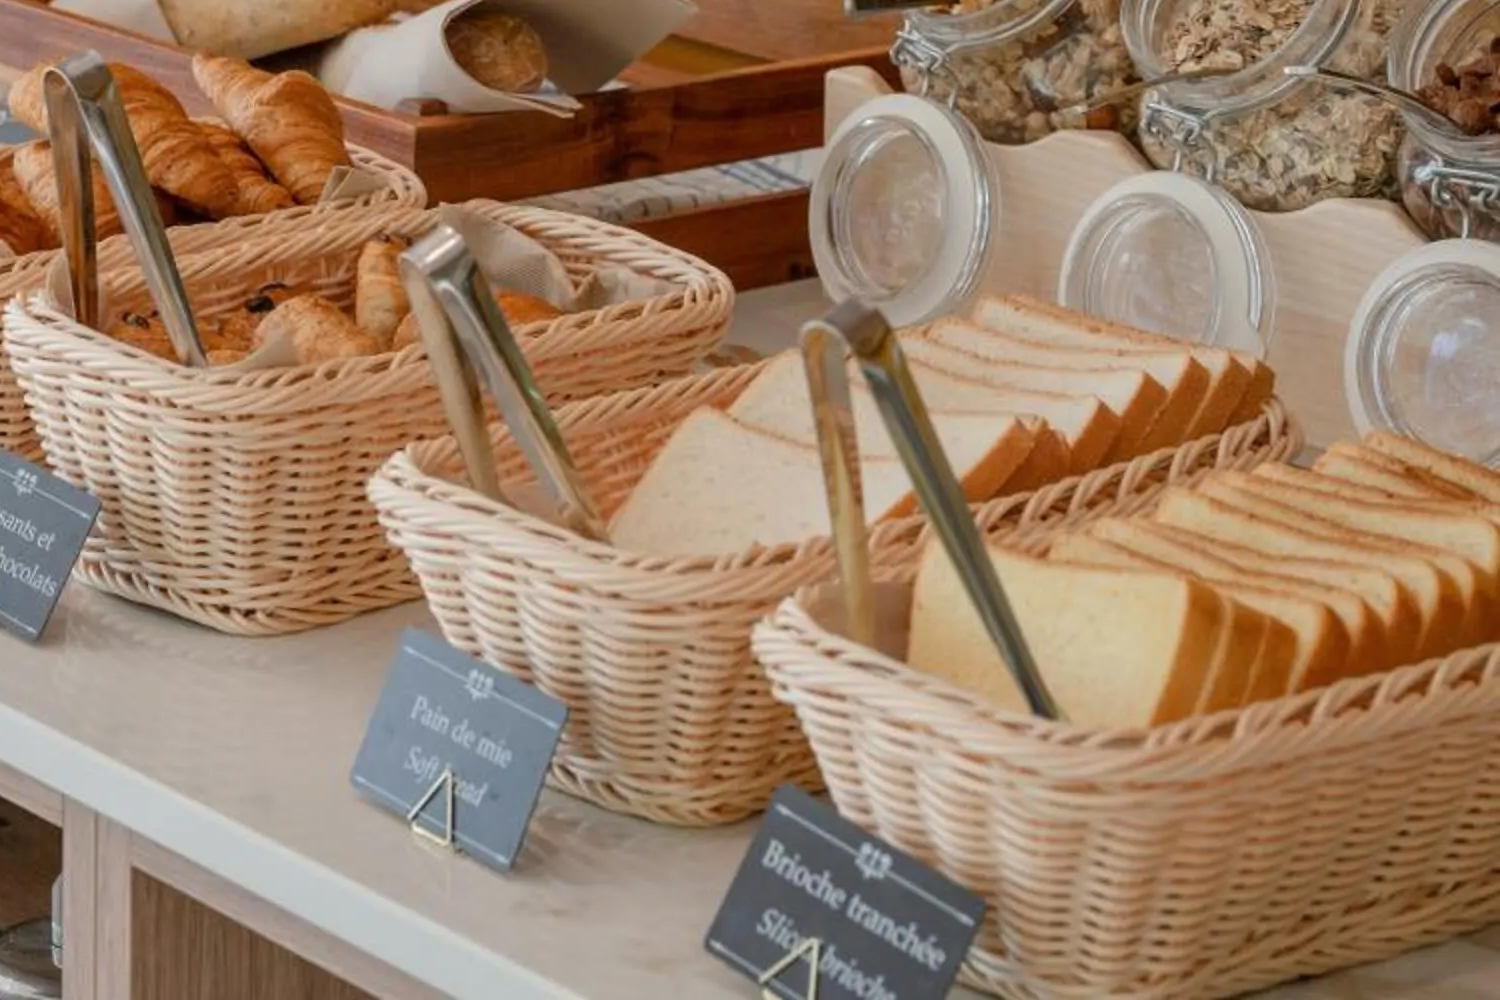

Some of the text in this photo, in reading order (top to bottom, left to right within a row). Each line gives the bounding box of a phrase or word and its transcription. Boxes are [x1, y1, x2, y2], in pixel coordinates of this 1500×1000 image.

[36, 531, 55, 552] et
[410, 695, 514, 769] Pain de mie
[761, 839, 947, 971] Brioche tranchée
